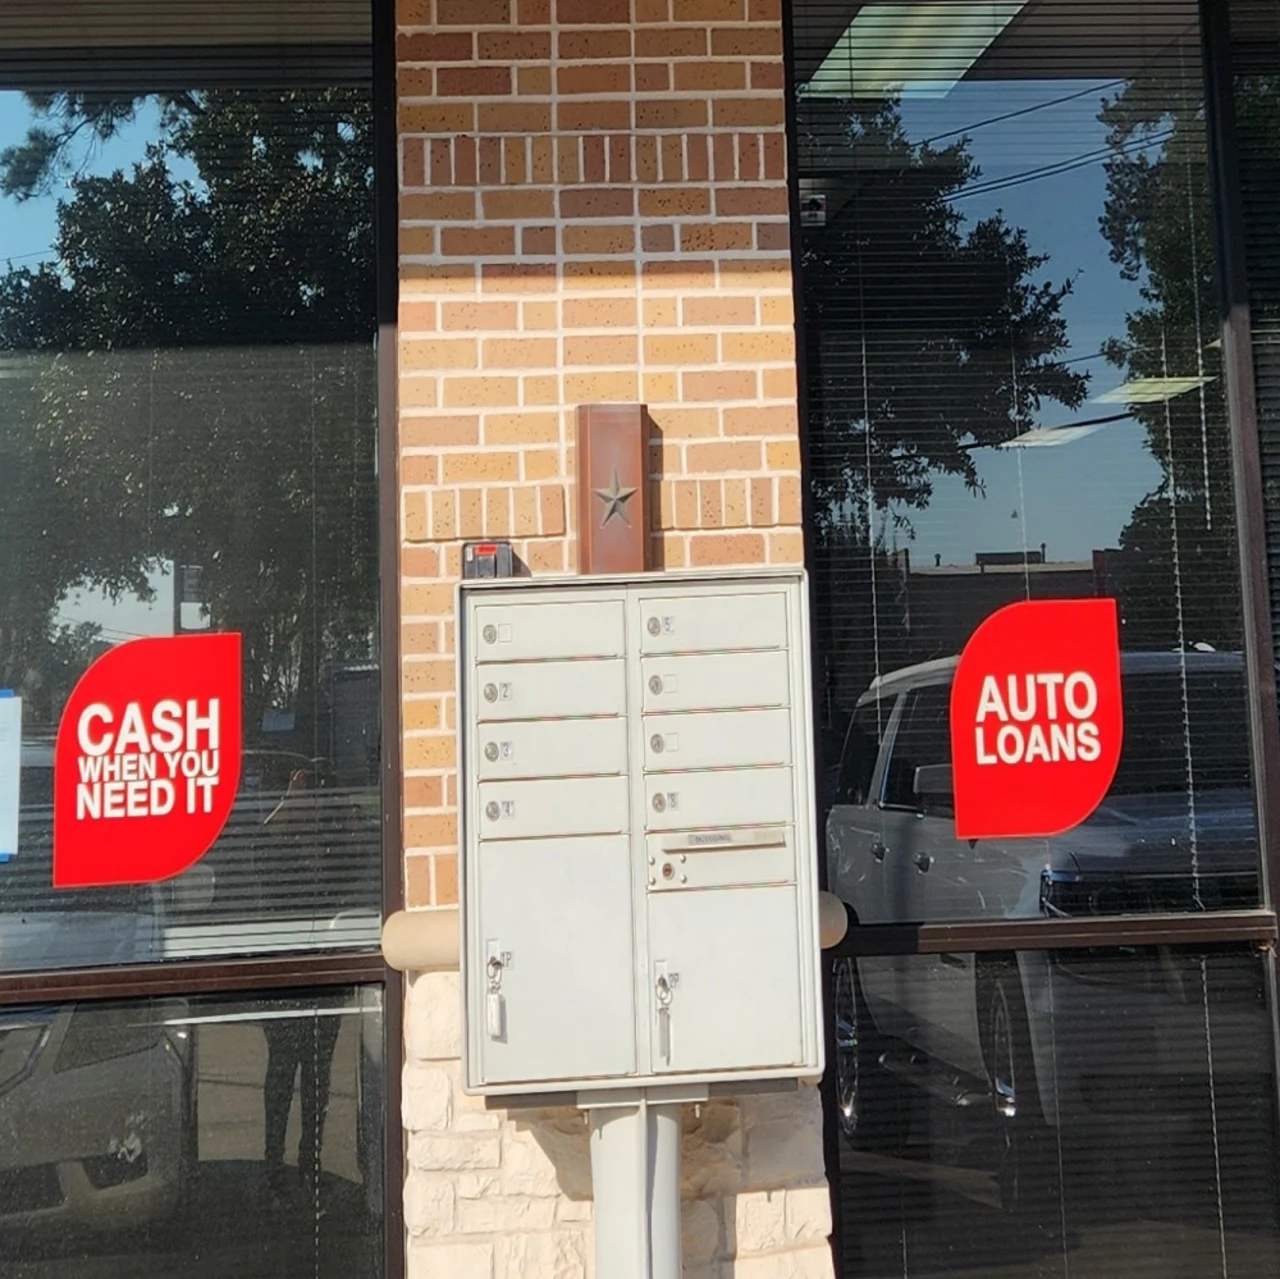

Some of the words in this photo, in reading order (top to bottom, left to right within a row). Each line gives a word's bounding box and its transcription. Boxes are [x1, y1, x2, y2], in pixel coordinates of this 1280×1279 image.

[975, 671, 1098, 722] AUTO
[77, 698, 220, 756] CASH
[975, 722, 1101, 765] LOANS
[78, 753, 157, 783] WHEN
[163, 750, 219, 777] YOU
[76, 780, 176, 820] NEED
[186, 777, 219, 814] IT
